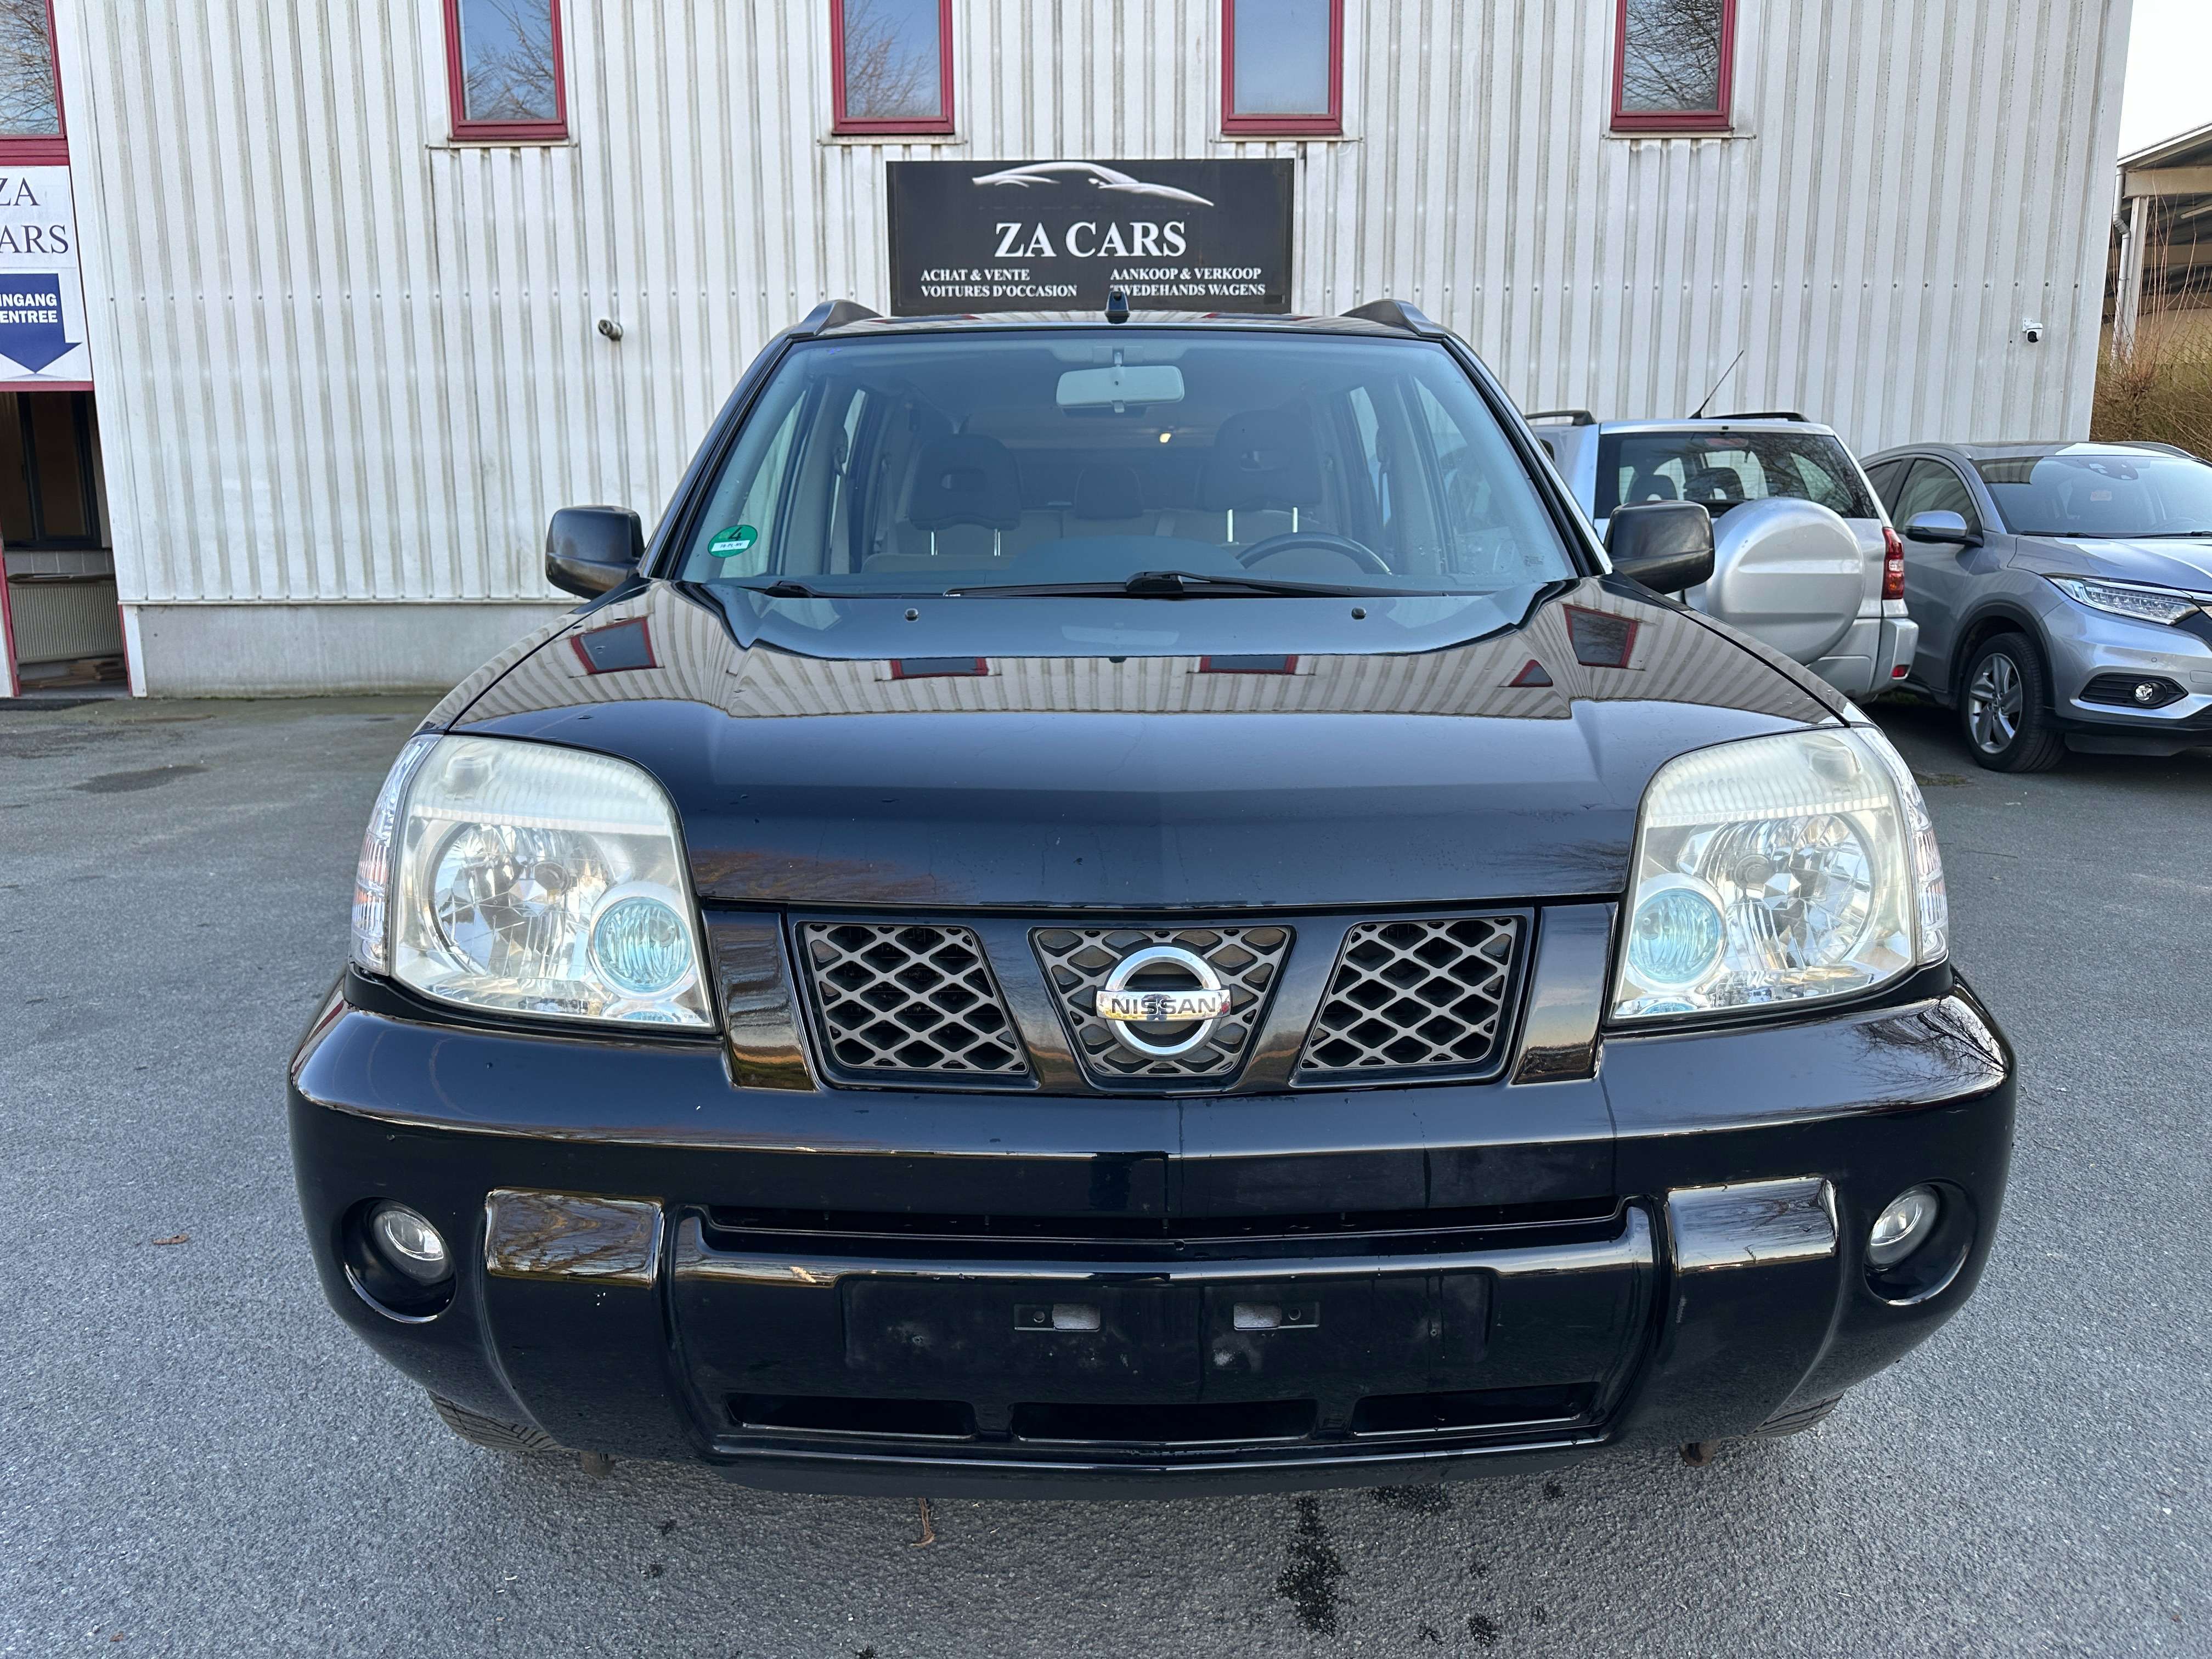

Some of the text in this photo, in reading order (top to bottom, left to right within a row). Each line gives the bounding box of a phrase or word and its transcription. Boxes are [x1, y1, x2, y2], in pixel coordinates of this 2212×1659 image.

[994, 221, 1187, 258] ZA CARS
[921, 268, 1030, 281] ACHAT & VENTE
[1110, 267, 1262, 280] AANKOOP & VERKOOP
[921, 284, 1077, 297] VOITURES D'OCCASION
[1207, 284, 1266, 296] WAGENS
[0, 310, 58, 323] ENTREE
[728, 527, 742, 540] 4
[1111, 997, 1216, 1014] NISSAN
